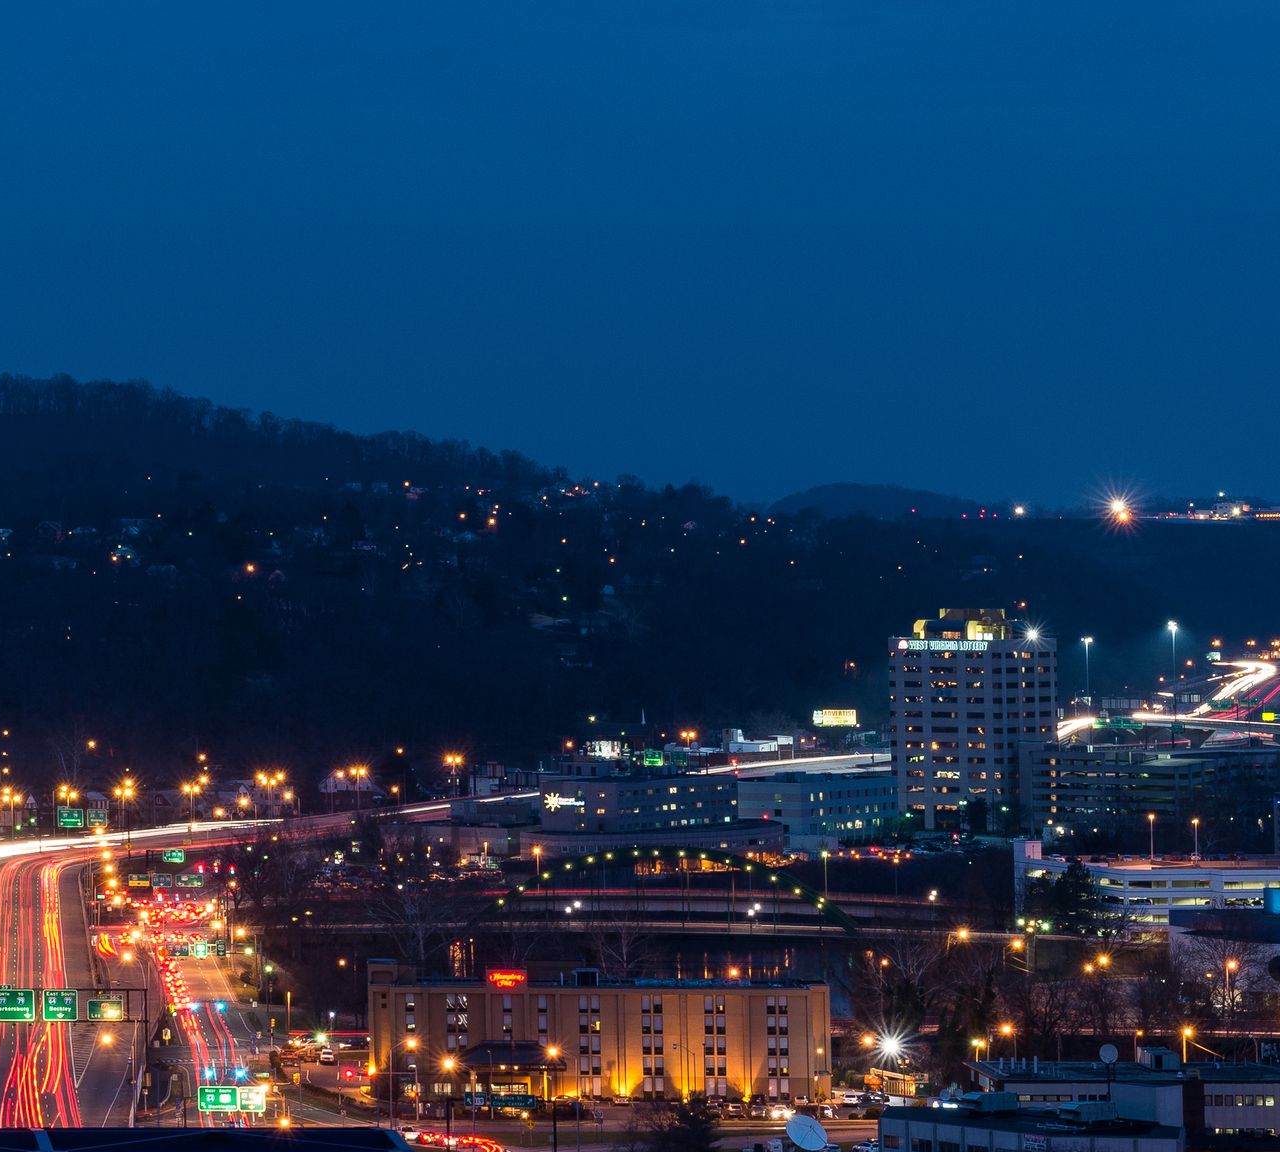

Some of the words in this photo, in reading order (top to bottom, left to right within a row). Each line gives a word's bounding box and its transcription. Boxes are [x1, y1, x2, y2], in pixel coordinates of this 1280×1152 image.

[908, 640, 928, 650] WEST
[929, 640, 959, 651] VIRGINIA
[959, 641, 988, 651] LOTTERY
[489, 972, 525, 981] Hampton
